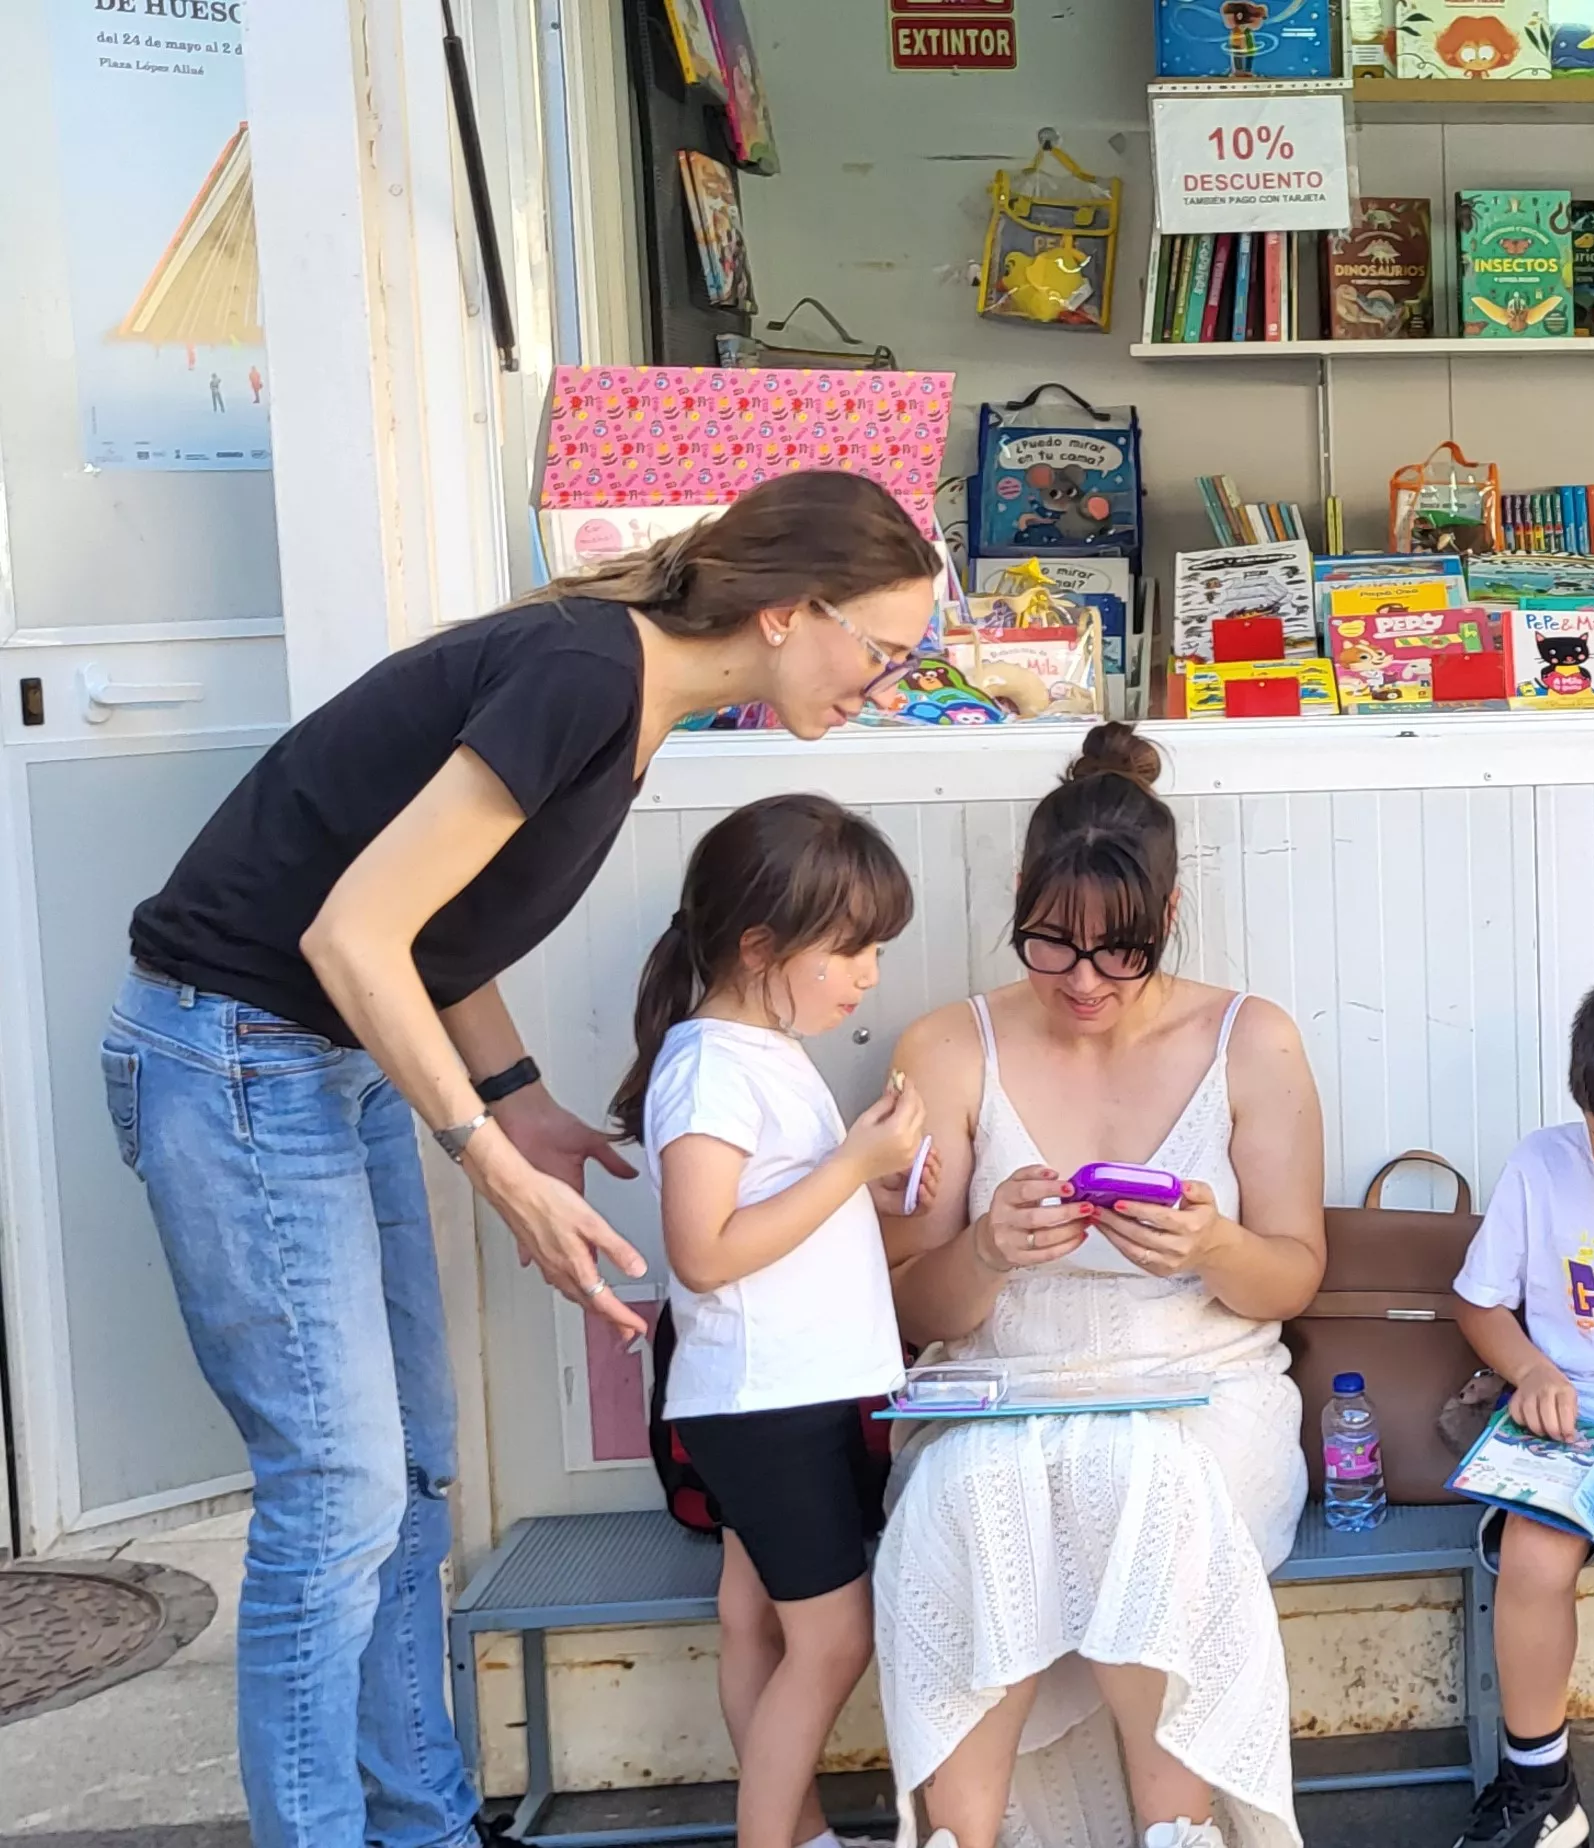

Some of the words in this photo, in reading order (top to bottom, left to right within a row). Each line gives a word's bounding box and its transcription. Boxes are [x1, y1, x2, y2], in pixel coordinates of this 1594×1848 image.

[97, 31, 118, 44] del
[123, 33, 140, 46] 24
[145, 36, 161, 48] de
[166, 40, 201, 53] mayo
[206, 42, 218, 53] al
[222, 43, 231, 54] 2
[898, 28, 1011, 56] EXTINTOR
[99, 57, 132, 69] Plaza
[1208, 125, 1294, 160] 10%
[1184, 171, 1323, 192] DESCUENTO
[1334, 264, 1425, 278] DINOSAURIOS
[1474, 258, 1558, 273] INSECTOS
[1016, 436, 1063, 453] ¿Puedo
[1069, 439, 1107, 453] mirar
[1017, 454, 1033, 464] en
[1039, 450, 1053, 461] tu
[1060, 452, 1105, 465] cama?
[1057, 568, 1096, 579] mirar
